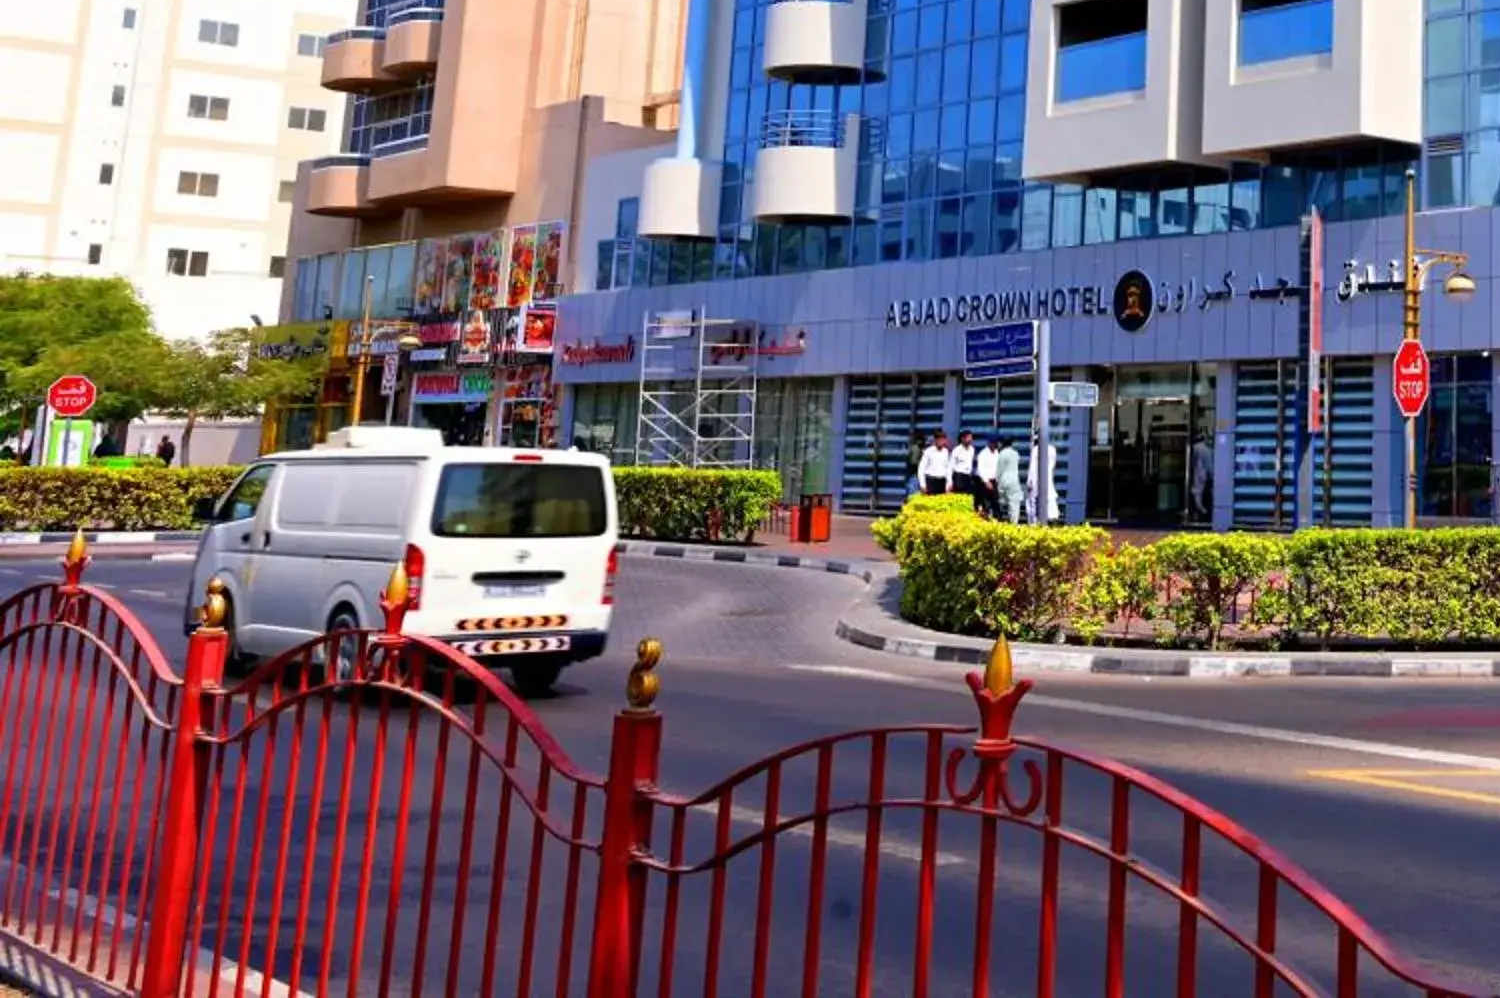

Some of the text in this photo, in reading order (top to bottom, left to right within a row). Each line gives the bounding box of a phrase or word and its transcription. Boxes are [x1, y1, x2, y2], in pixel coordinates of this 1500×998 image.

[885, 287, 1110, 328] ABJAD CROWN HOTEL
[1399, 380, 1423, 399] STOP
[55, 396, 87, 408] STOP
